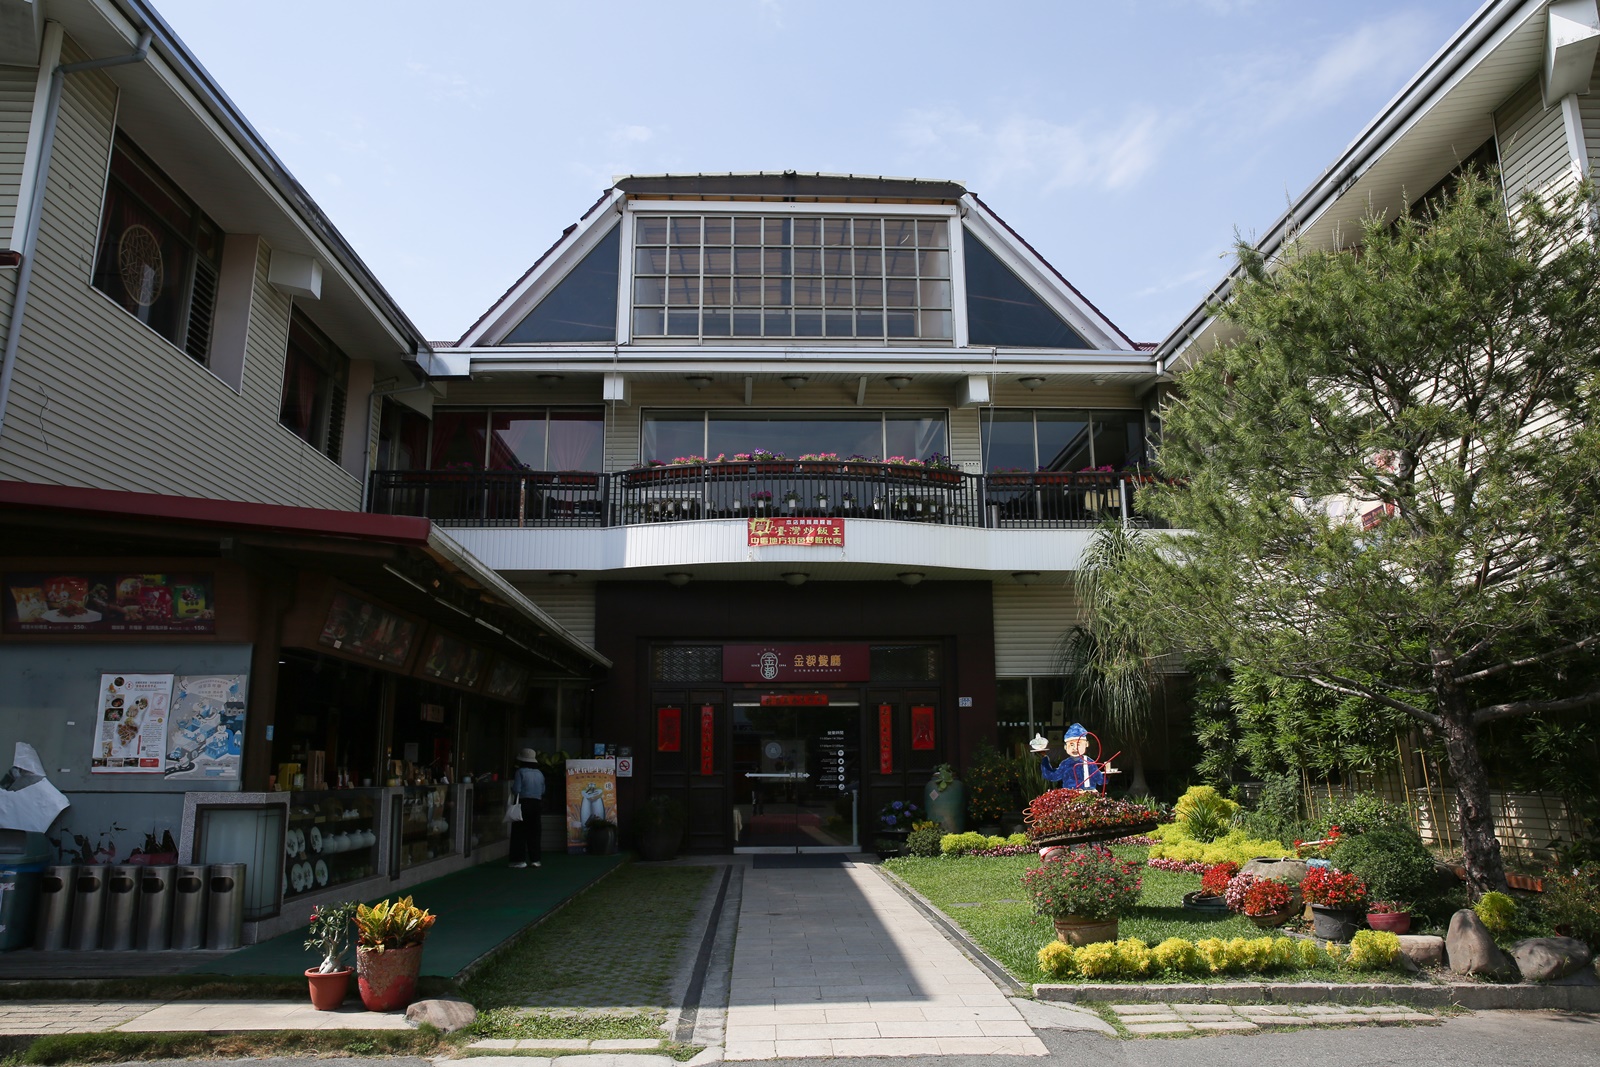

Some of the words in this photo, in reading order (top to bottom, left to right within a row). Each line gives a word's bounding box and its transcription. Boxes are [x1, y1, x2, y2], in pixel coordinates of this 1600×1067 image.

[775, 526, 841, 536] 臺灣炒飯王
[794, 654, 842, 667] 金都餐廳
